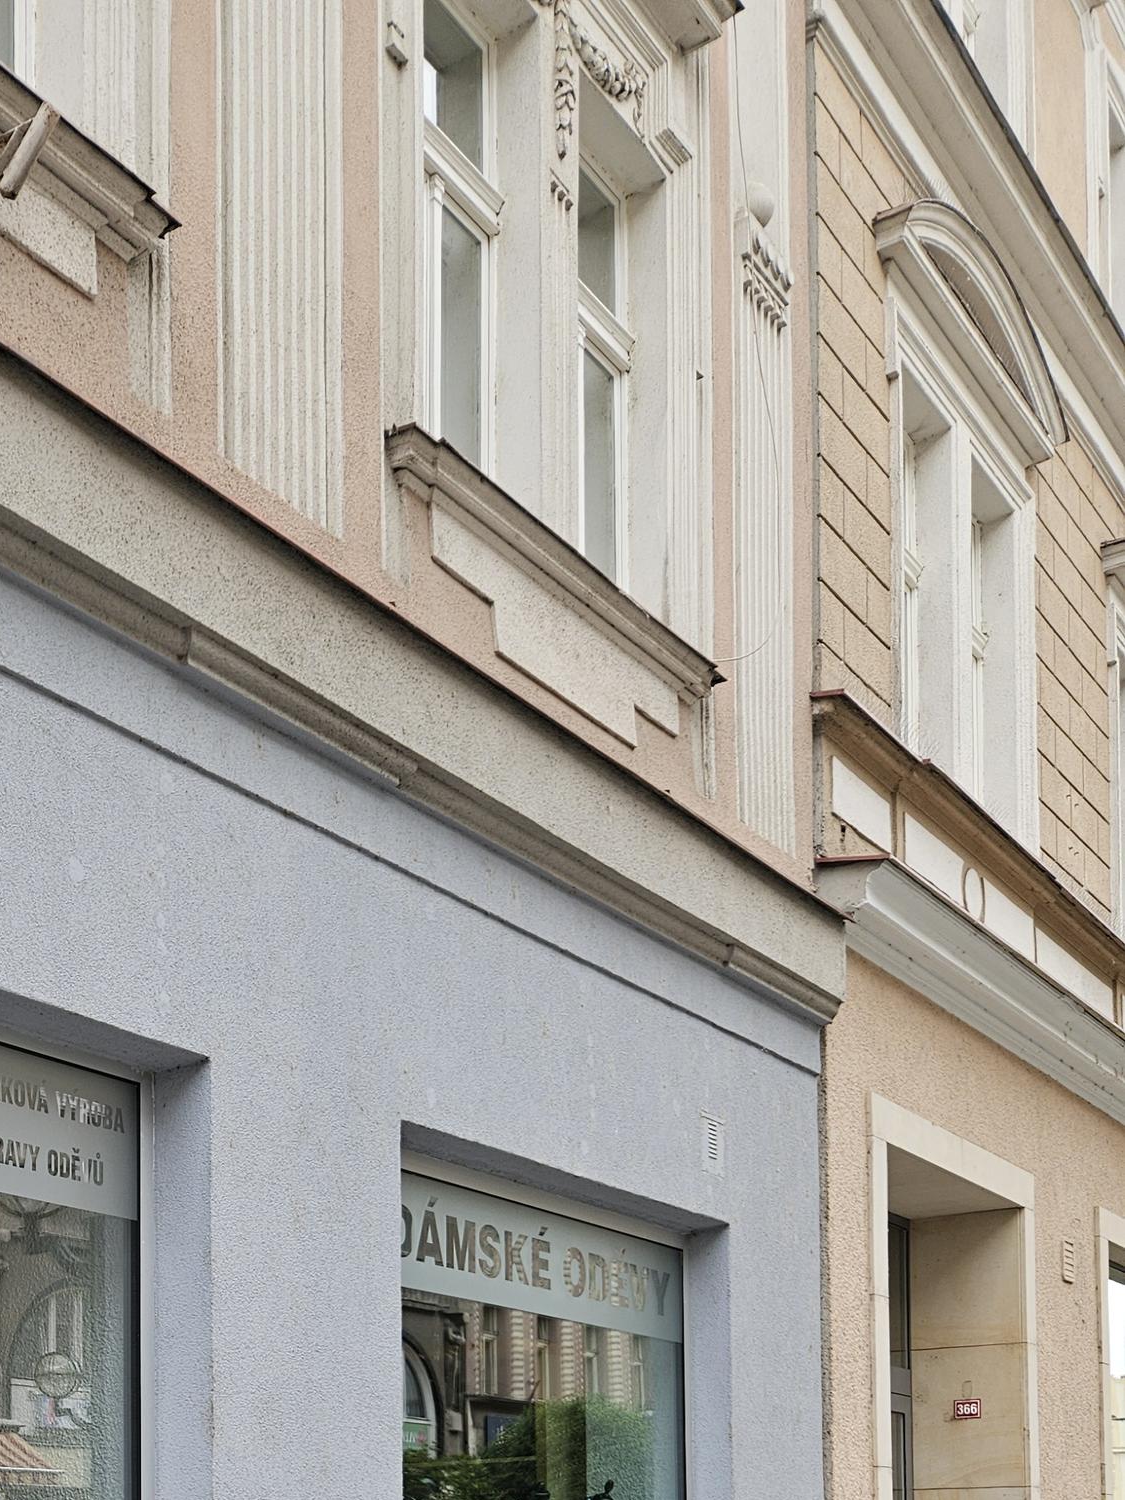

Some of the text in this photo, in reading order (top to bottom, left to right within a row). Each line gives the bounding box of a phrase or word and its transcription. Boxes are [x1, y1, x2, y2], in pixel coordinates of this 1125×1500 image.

[55, 1089, 125, 1134] VÝROBA
[47, 1147, 104, 1186] ODĚVŮ
[957, 1403, 978, 1415] 366
